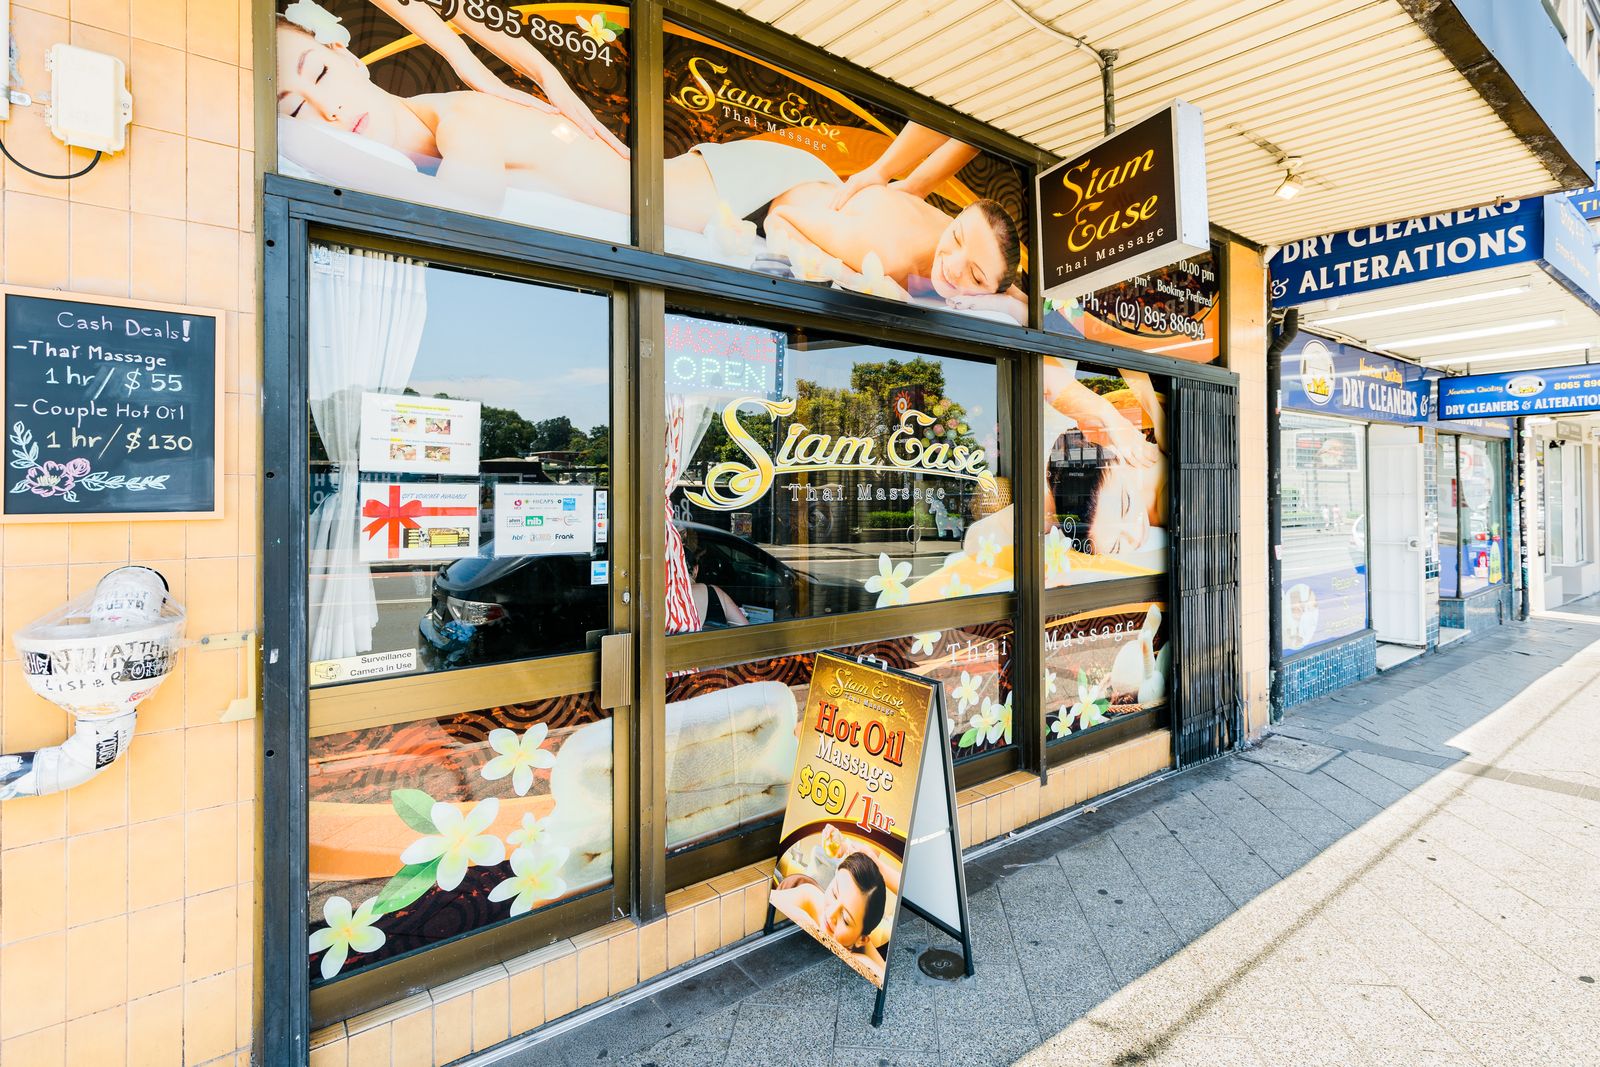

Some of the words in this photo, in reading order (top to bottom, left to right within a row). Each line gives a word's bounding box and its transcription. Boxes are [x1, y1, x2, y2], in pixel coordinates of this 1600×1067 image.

[467, 0, 521, 34] 895
[530, 17, 614, 67] 88694
[670, 56, 772, 113] Siam
[779, 92, 841, 141] Ease
[722, 106, 758, 128] Thai
[766, 121, 828, 151] Massage
[1052, 148, 1155, 217] Siam
[1067, 194, 1159, 253] Ease
[1056, 256, 1087, 277] Thai
[1095, 227, 1164, 262] Massage
[1270, 277, 1289, 299] &
[1298, 225, 1527, 294] ALTERATIONS
[1282, 232, 1336, 264] DRY
[1157, 278, 1185, 302] Booking
[1201, 269, 1215, 283] pm
[57, 311, 113, 331] Cash
[125, 318, 191, 342] Deals!
[1115, 295, 1141, 328] (02)
[1144, 306, 1167, 331] 895
[1170, 313, 1205, 340] 88694
[88, 345, 167, 371] Massage
[673, 356, 766, 390] OPEN
[116, 403, 150, 419] Hot
[156, 405, 184, 420] Oil
[1342, 377, 1366, 409] DRY
[1368, 382, 1418, 417] CLEANERS
[1420, 395, 1429, 417] &
[1445, 403, 1466, 416] DRY
[1467, 400, 1520, 414] CLEANERS
[1521, 400, 1532, 411] &
[1534, 393, 1600, 410] ALTERATIO
[682, 396, 878, 511] Siam
[887, 409, 988, 473] Ease
[788, 483, 848, 502] Thai
[857, 483, 946, 504] Massage
[361, 651, 412, 664] Surveillance
[947, 635, 1008, 665] Thai
[1044, 619, 1135, 651] Massage
[350, 666, 384, 677] Camera
[386, 664, 394, 672] in
[396, 662, 412, 670] Use
[827, 667, 868, 699] Siam
[872, 680, 904, 708] Ease
[844, 693, 861, 705] Thai
[863, 700, 896, 717] Massage
[814, 700, 861, 747] Hot
[863, 720, 906, 767] Oil
[816, 733, 893, 792] Massage
